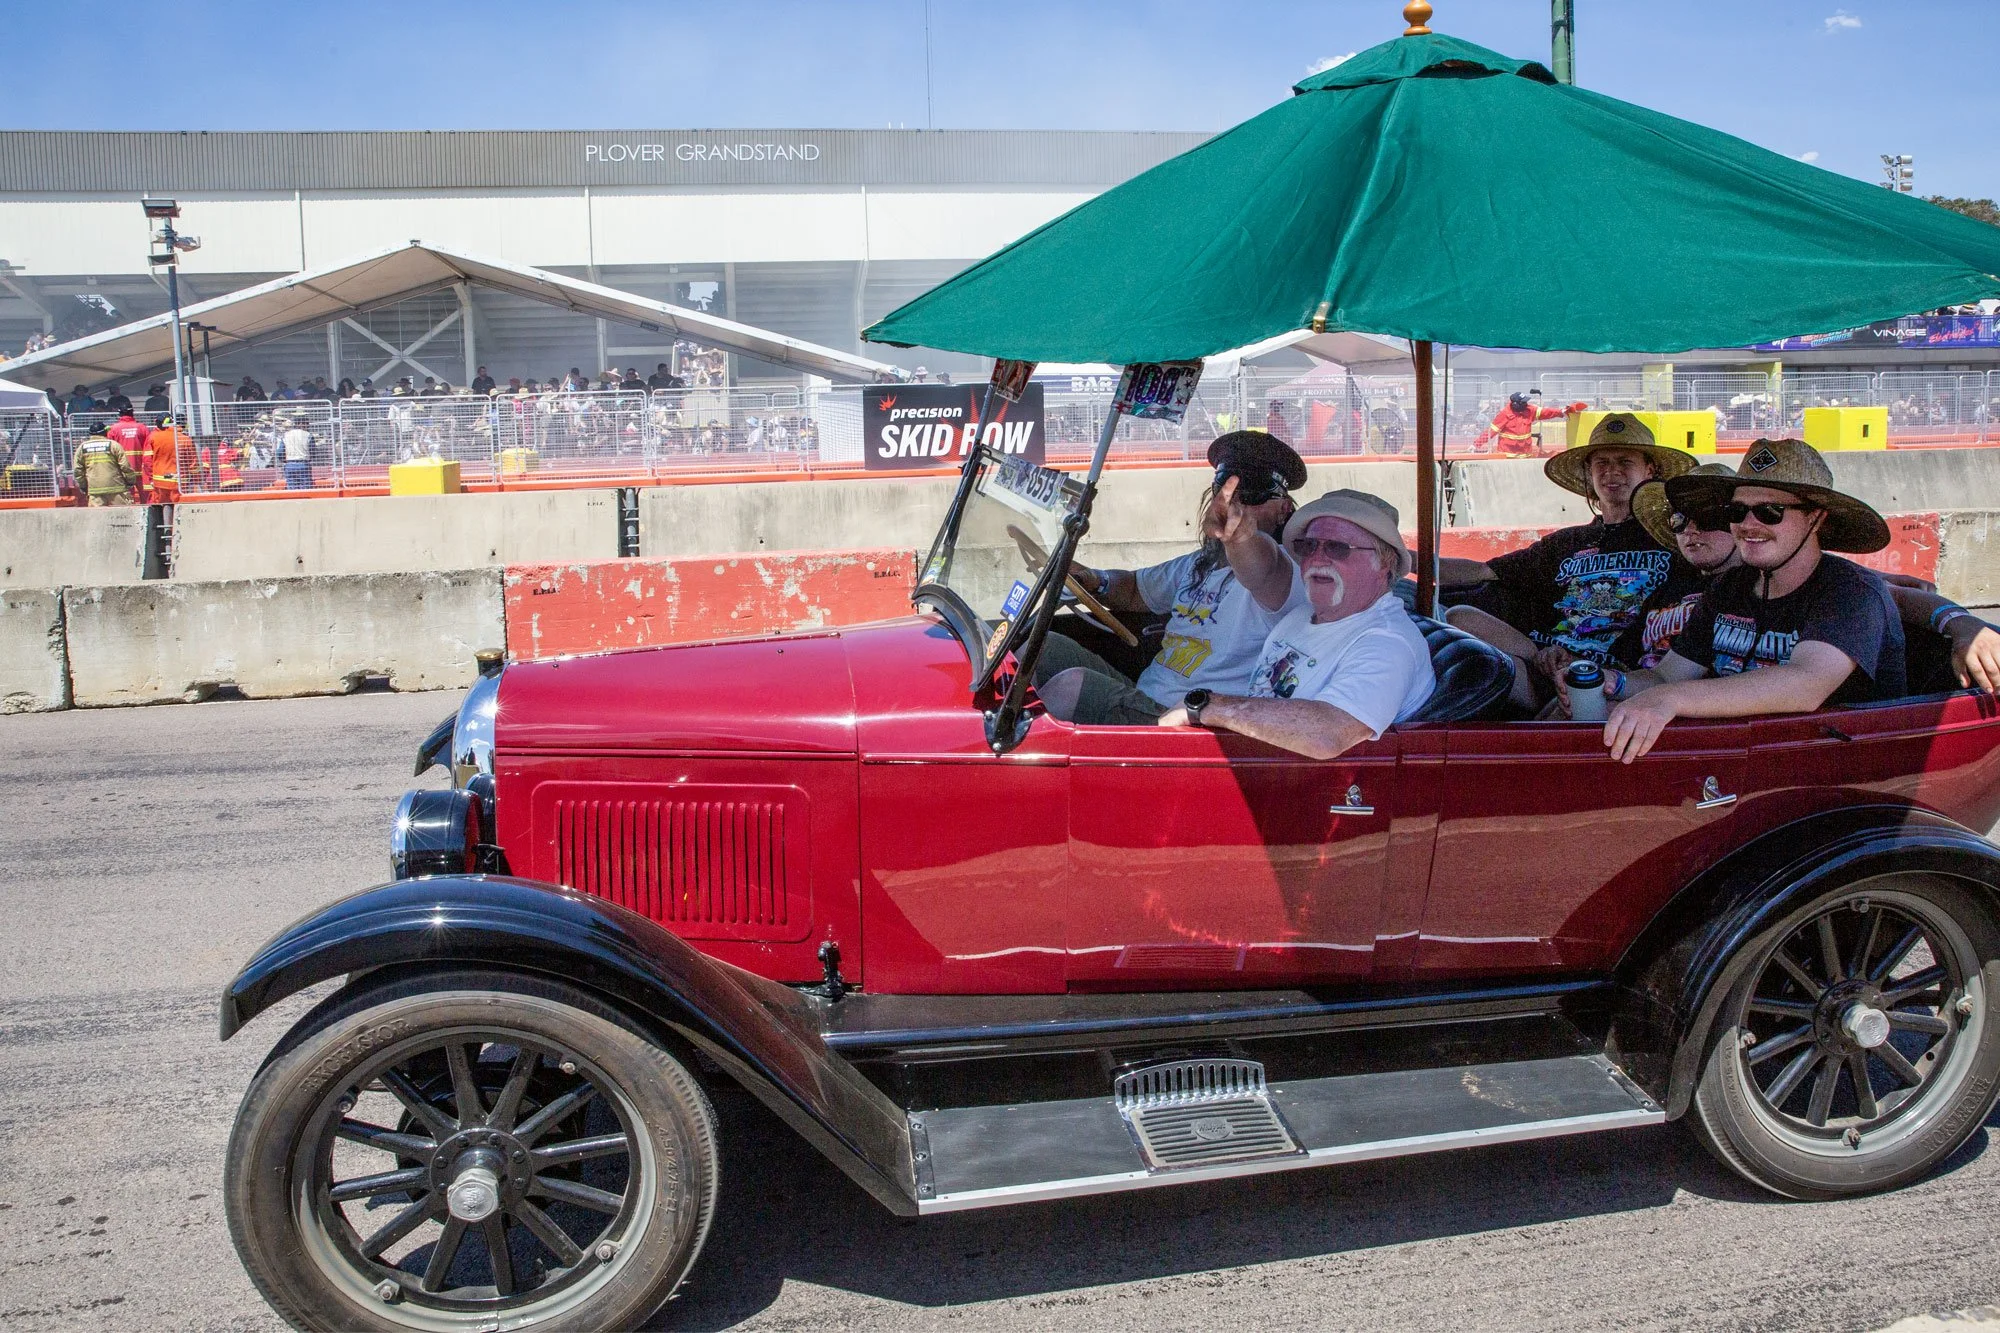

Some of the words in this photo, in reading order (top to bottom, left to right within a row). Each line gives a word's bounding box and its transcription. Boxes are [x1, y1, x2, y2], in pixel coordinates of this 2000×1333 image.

[586, 144, 665, 162] PLOVER
[676, 143, 820, 161] GRANDSTAND
[1873, 328, 1927, 338] VINAGE
[1071, 376, 1113, 392] BAR
[1303, 388, 1334, 396] FROZEN
[890, 407, 963, 422] precision
[878, 423, 954, 459] SKID
[958, 421, 1035, 456] ROW
[1026, 466, 1060, 503] 0573
[1555, 550, 1672, 581] SUMMERNATS
[1647, 571, 1669, 588] 38
